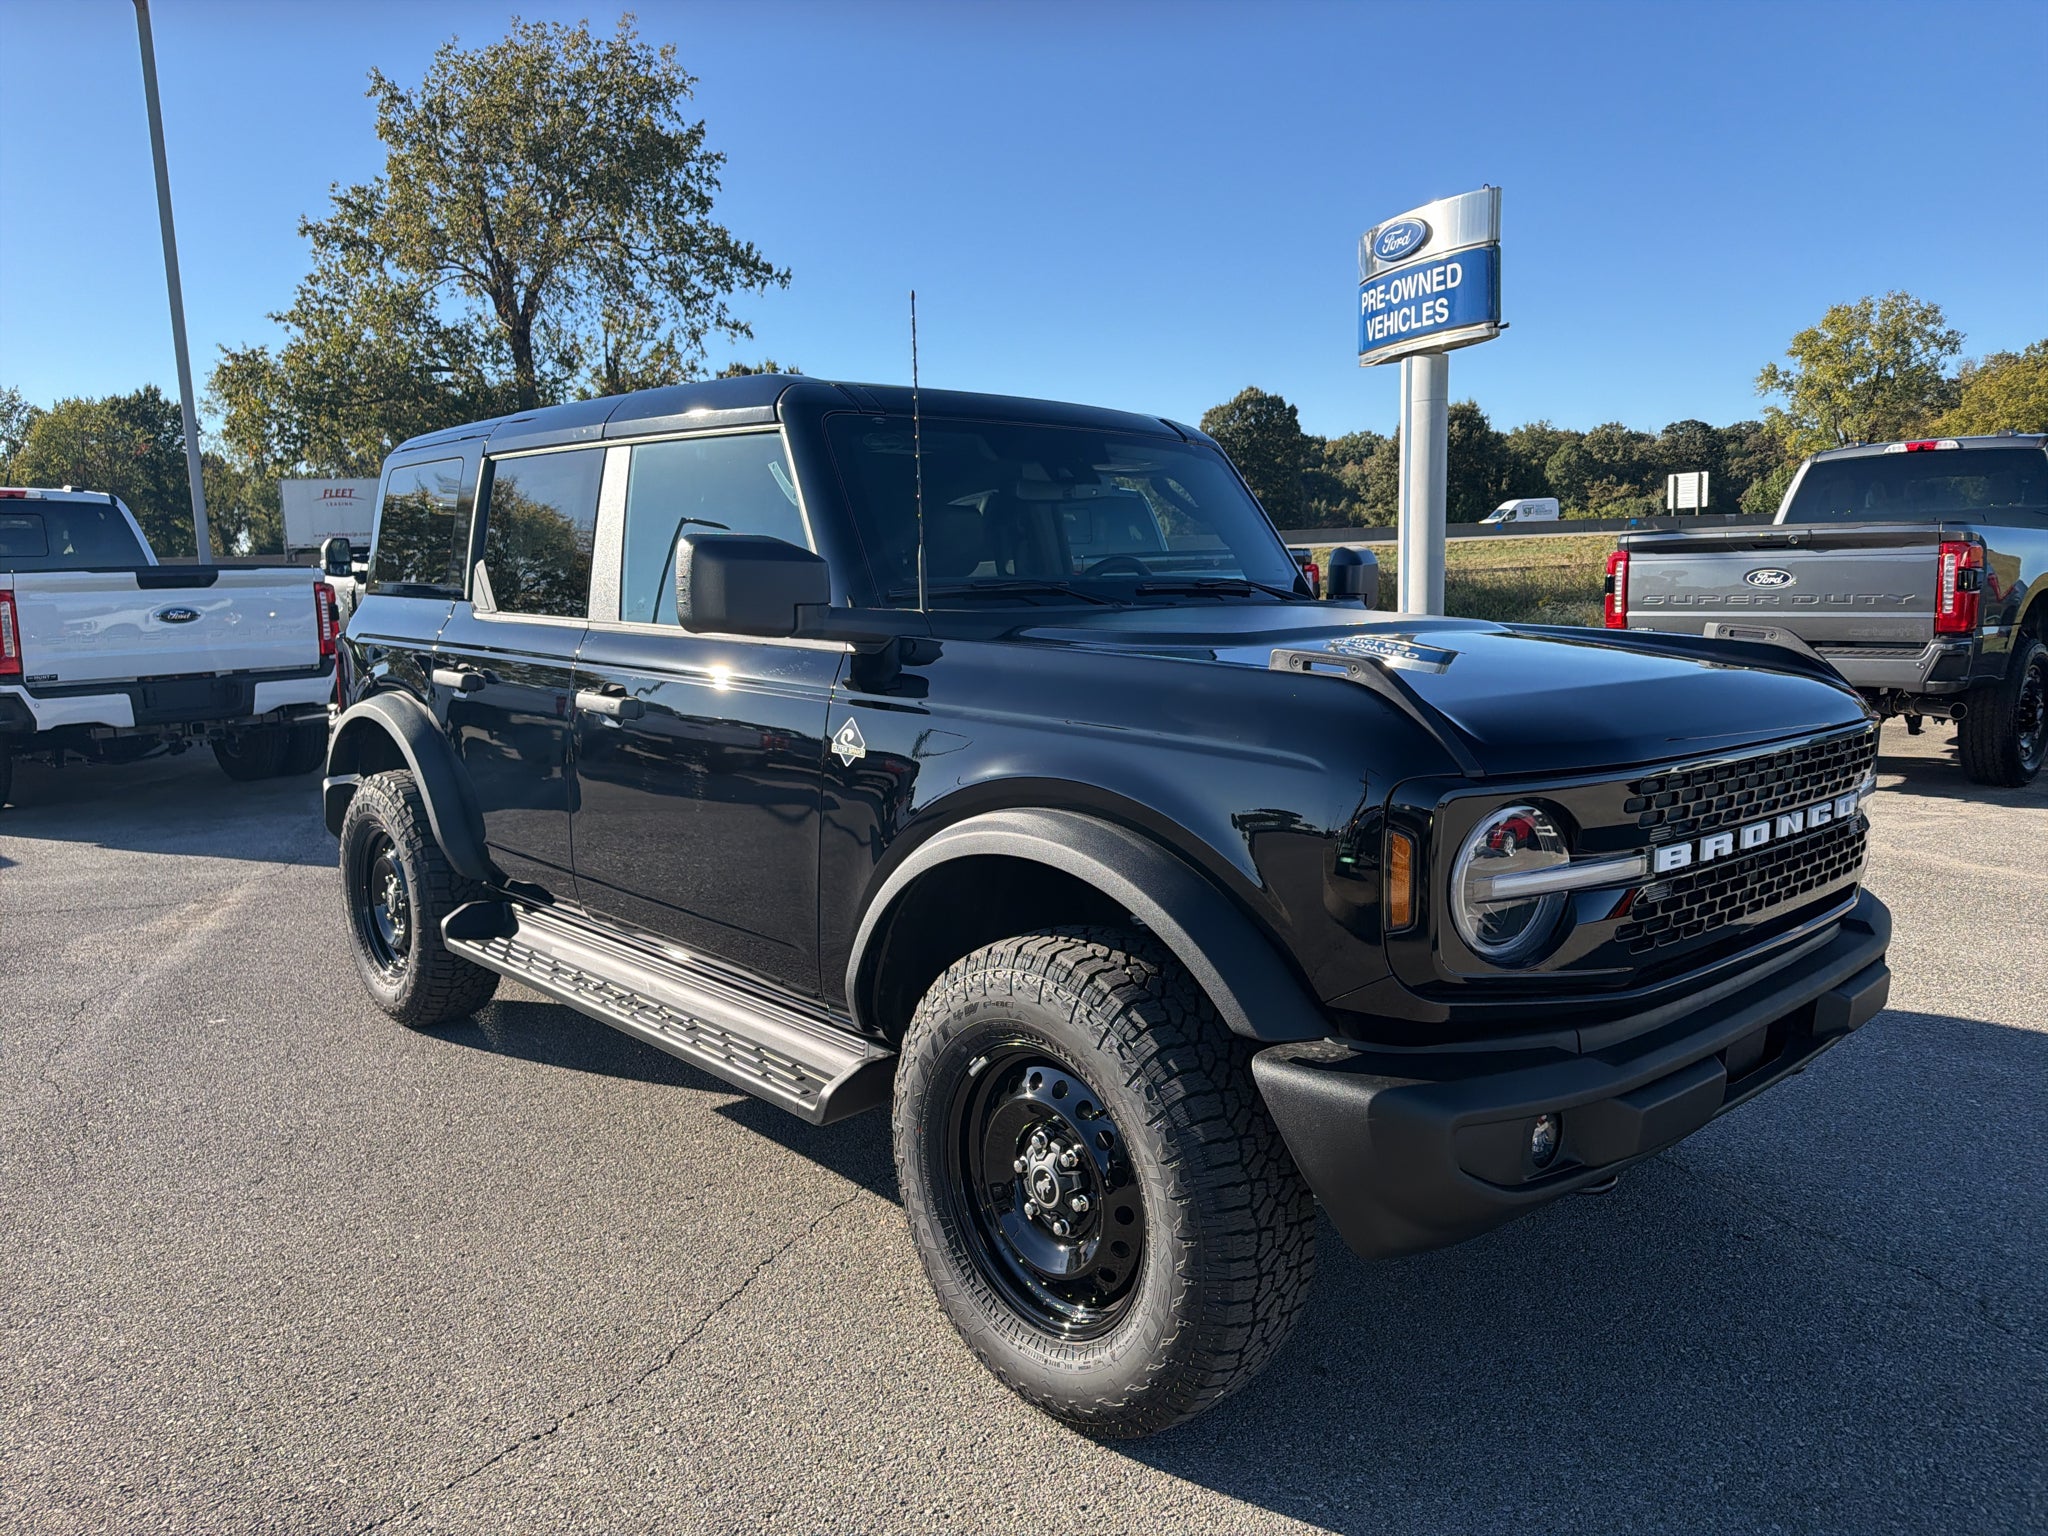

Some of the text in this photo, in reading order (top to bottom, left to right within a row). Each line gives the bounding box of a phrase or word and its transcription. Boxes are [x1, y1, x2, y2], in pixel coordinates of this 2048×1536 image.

[1382, 228, 1412, 254] Ford
[1361, 262, 1463, 316] PRE-OWNED
[1366, 297, 1450, 342] VEHICLES
[322, 488, 355, 499] FLEET
[1753, 571, 1784, 585] Ford
[1642, 594, 1916, 606] SUPER DUTY
[1653, 791, 1860, 874] BRONCO
